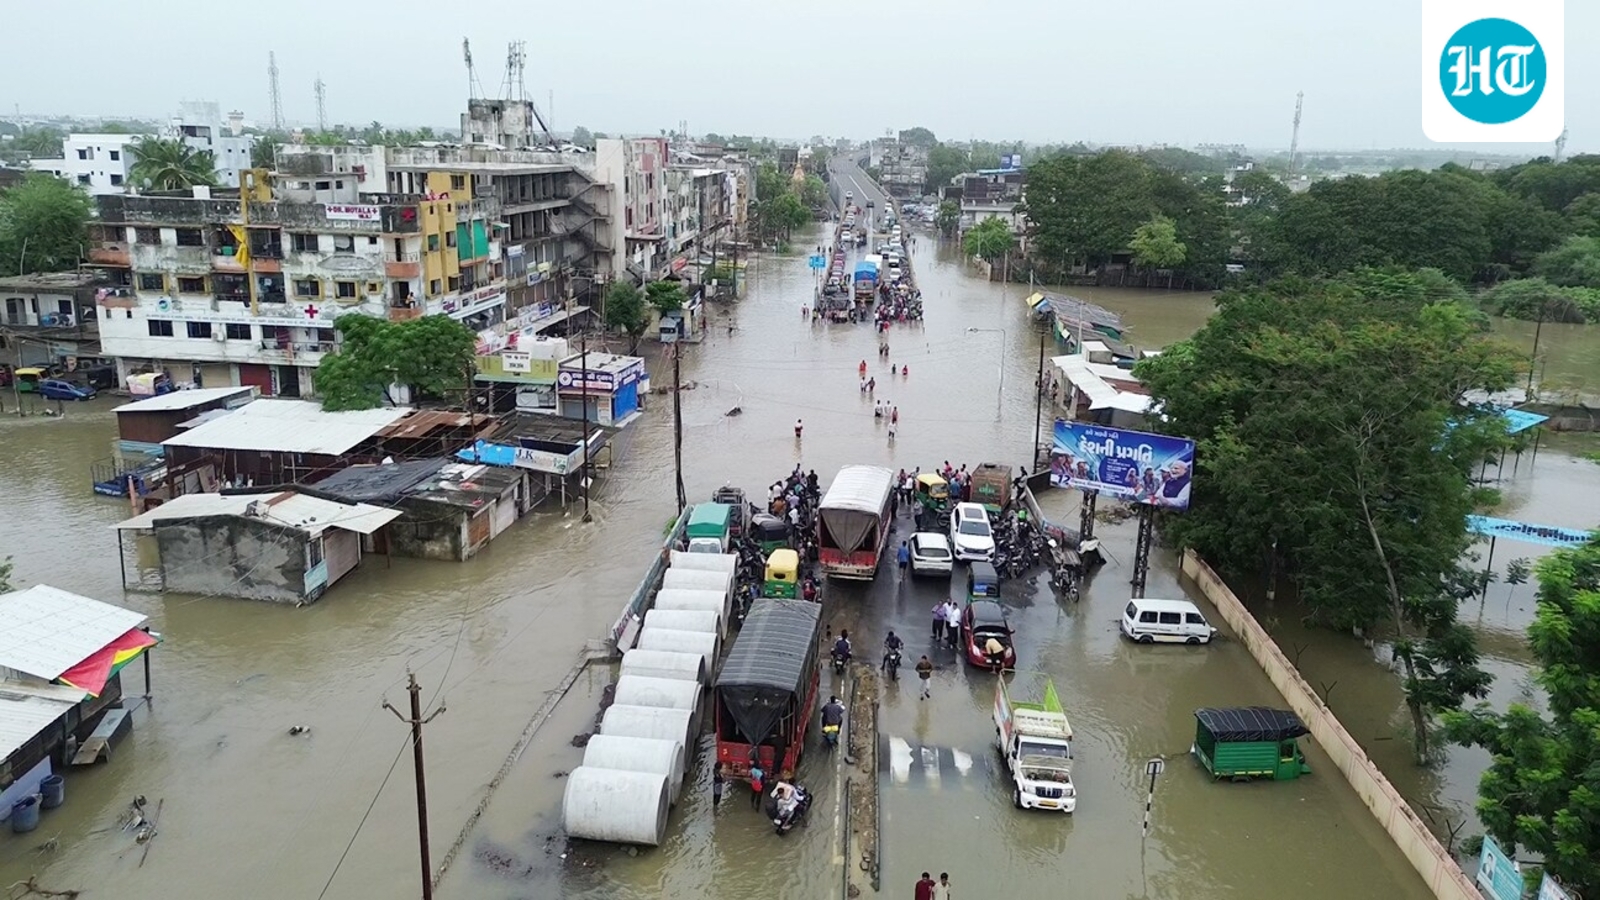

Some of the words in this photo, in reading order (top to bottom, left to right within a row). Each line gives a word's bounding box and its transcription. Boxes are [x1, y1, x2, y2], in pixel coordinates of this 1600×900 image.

[1079, 434, 1114, 458] દેશની
[1116, 443, 1153, 463] પ્રગતિ
[1058, 474, 1070, 486] 12
